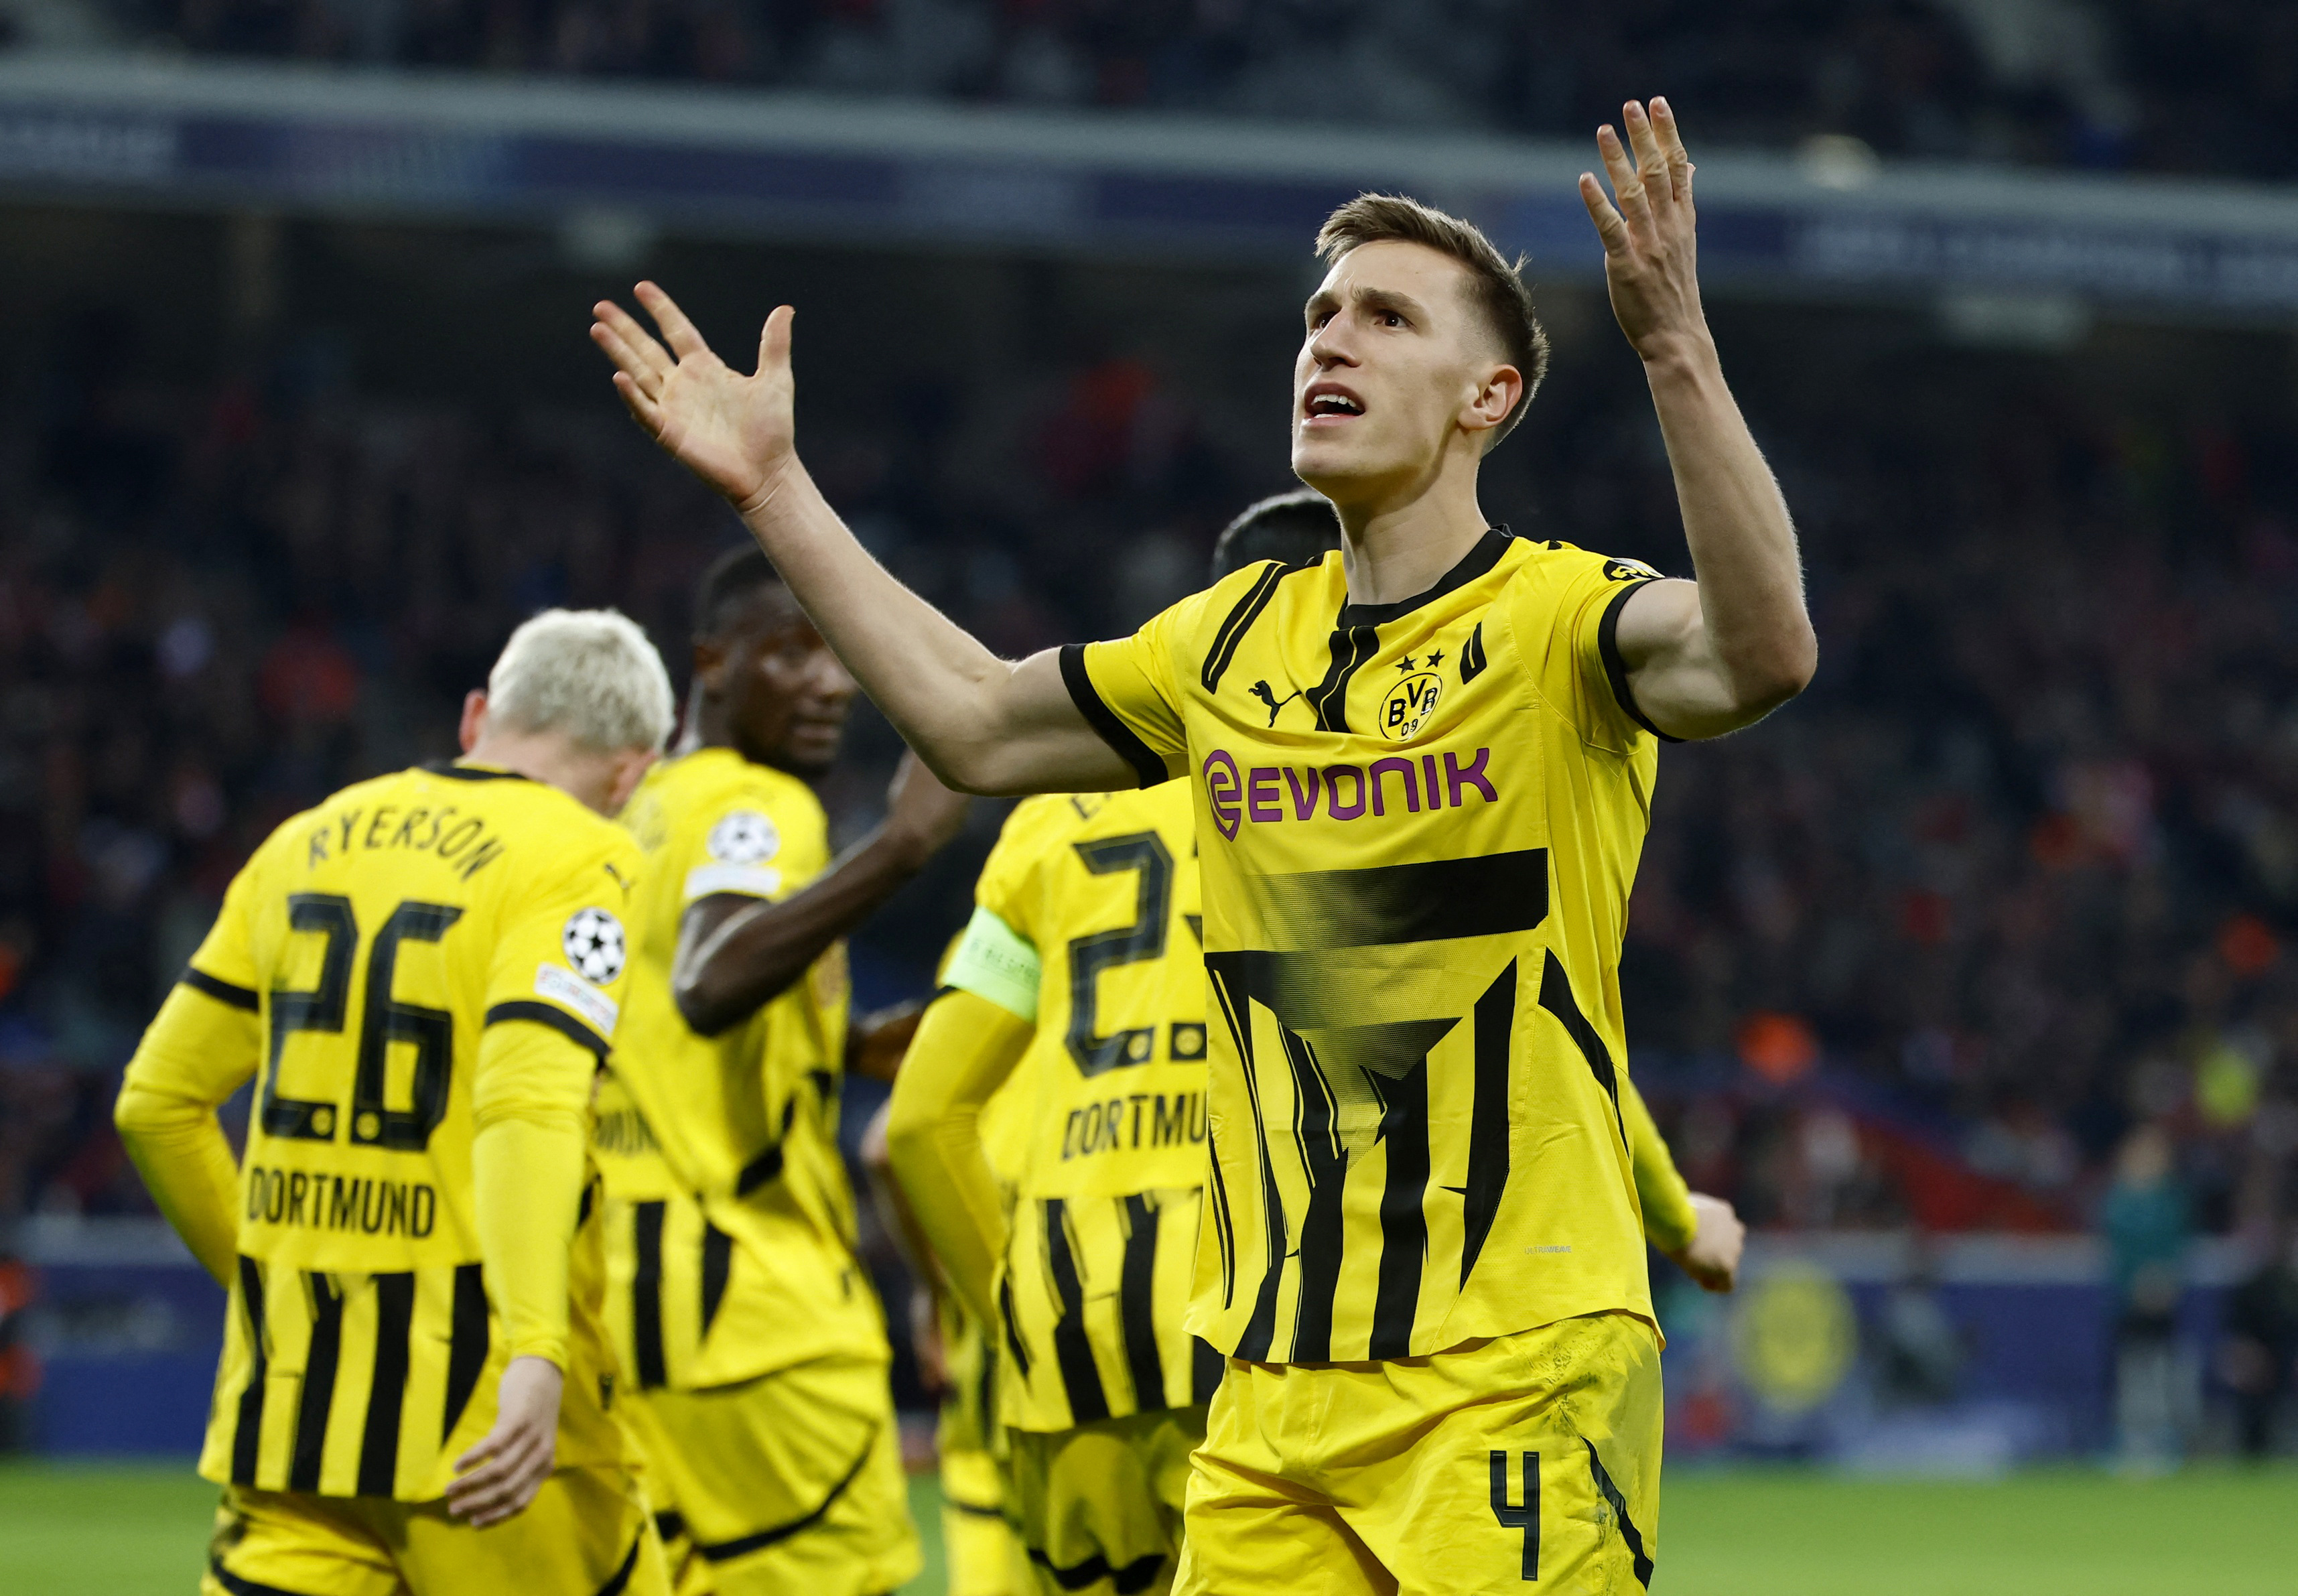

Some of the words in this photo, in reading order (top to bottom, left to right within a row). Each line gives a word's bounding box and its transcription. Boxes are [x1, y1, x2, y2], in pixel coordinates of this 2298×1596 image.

[1388, 678, 1438, 728] BVB
[1401, 718, 1418, 736] 09
[1248, 748, 1498, 823] EVONIK
[308, 805, 505, 882] RYERSON
[1063, 830, 1207, 1079] 2
[261, 891, 465, 1152] 26
[1062, 1091, 1207, 1160] DORTMU
[249, 1167, 435, 1238] DORTMUND
[1524, 1246, 1572, 1254] ULTRAWEAVE
[1489, 1450, 1540, 1581] 4
